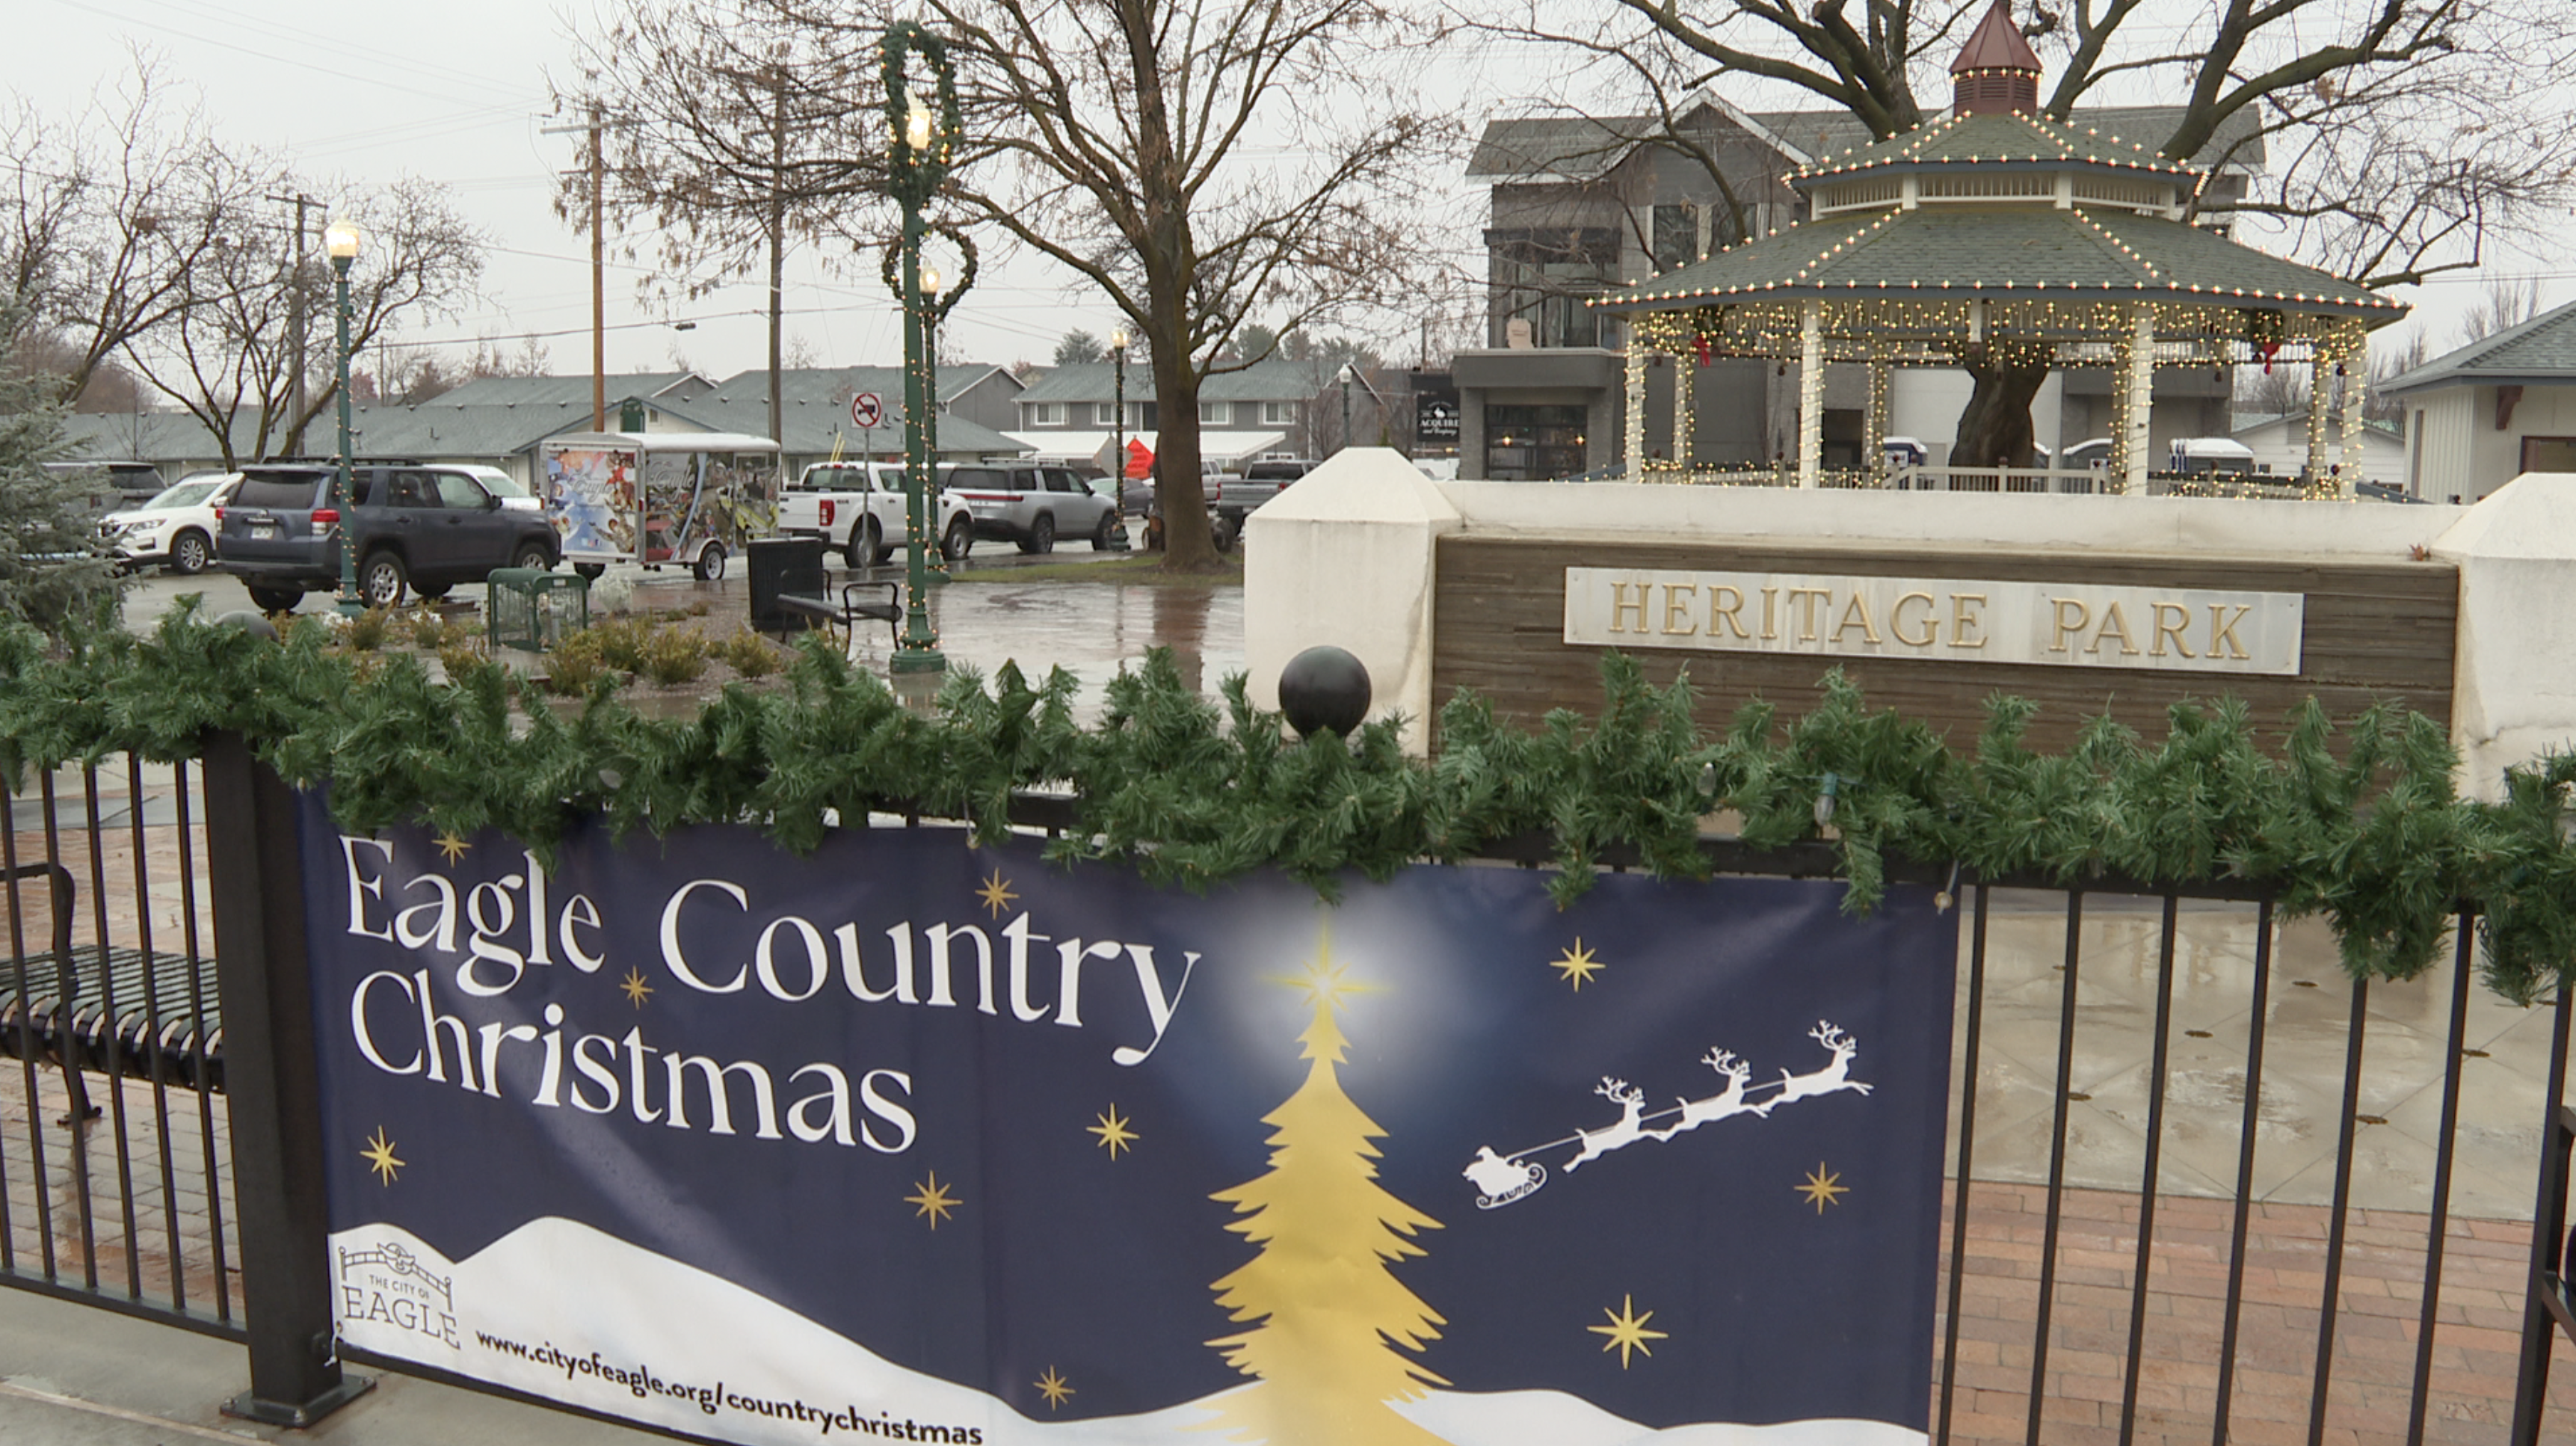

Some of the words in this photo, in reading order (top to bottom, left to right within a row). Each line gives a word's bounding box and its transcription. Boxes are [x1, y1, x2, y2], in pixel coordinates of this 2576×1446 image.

[1607, 581, 1988, 648] HERITAGE
[2049, 597, 2252, 660] PARK
[339, 834, 605, 997] Eagle
[659, 879, 1203, 1066] Country
[351, 969, 917, 1154] Christmas
[341, 1285, 461, 1351] EAGLE
[369, 1274, 389, 1289] THE
[392, 1280, 416, 1295] CITY
[475, 1330, 984, 1446] www.cityofeagle.org/countrychristmas
